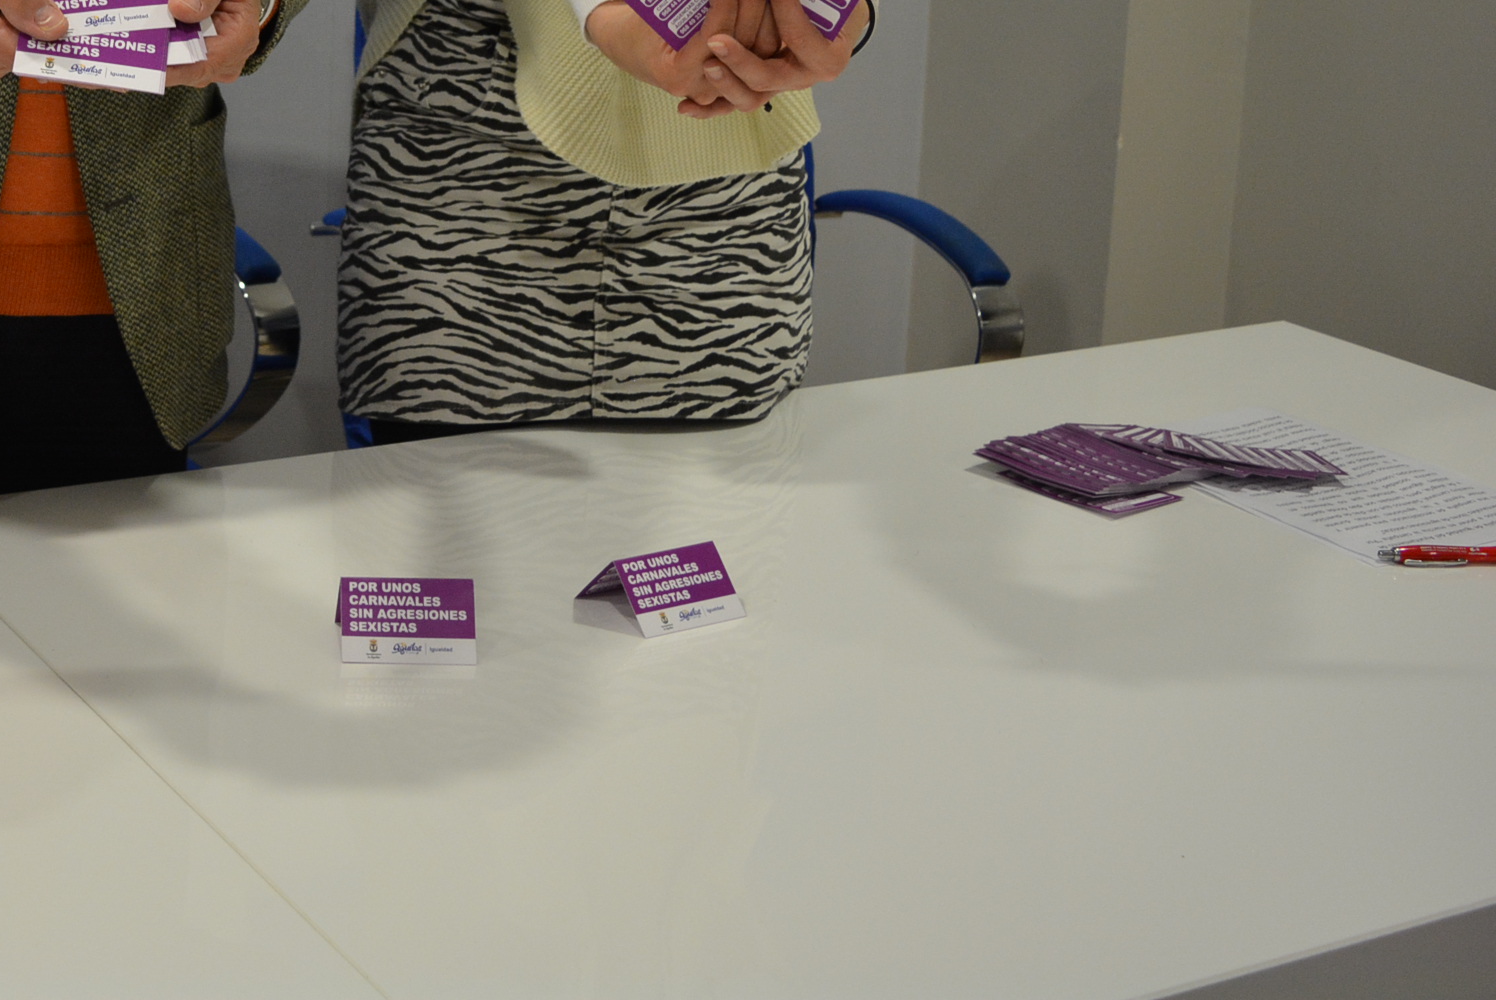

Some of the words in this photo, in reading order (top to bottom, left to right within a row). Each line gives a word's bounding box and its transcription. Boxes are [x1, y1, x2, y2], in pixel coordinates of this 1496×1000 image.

[27, 40, 100, 57] SEXISTAS
[622, 560, 646, 573] POR
[647, 553, 679, 569] UNOS
[627, 562, 699, 585] CARNAVALES
[349, 582, 377, 593] POR
[381, 582, 421, 593] UNOS
[632, 584, 652, 597] SIN
[655, 570, 723, 593] AGRESIONES
[349, 595, 441, 607] CARNAVALES
[637, 590, 691, 609] SEXISTAS
[349, 608, 373, 619] SIN
[377, 609, 467, 620] AGRESIONES
[350, 621, 417, 633] SEXISTAS
